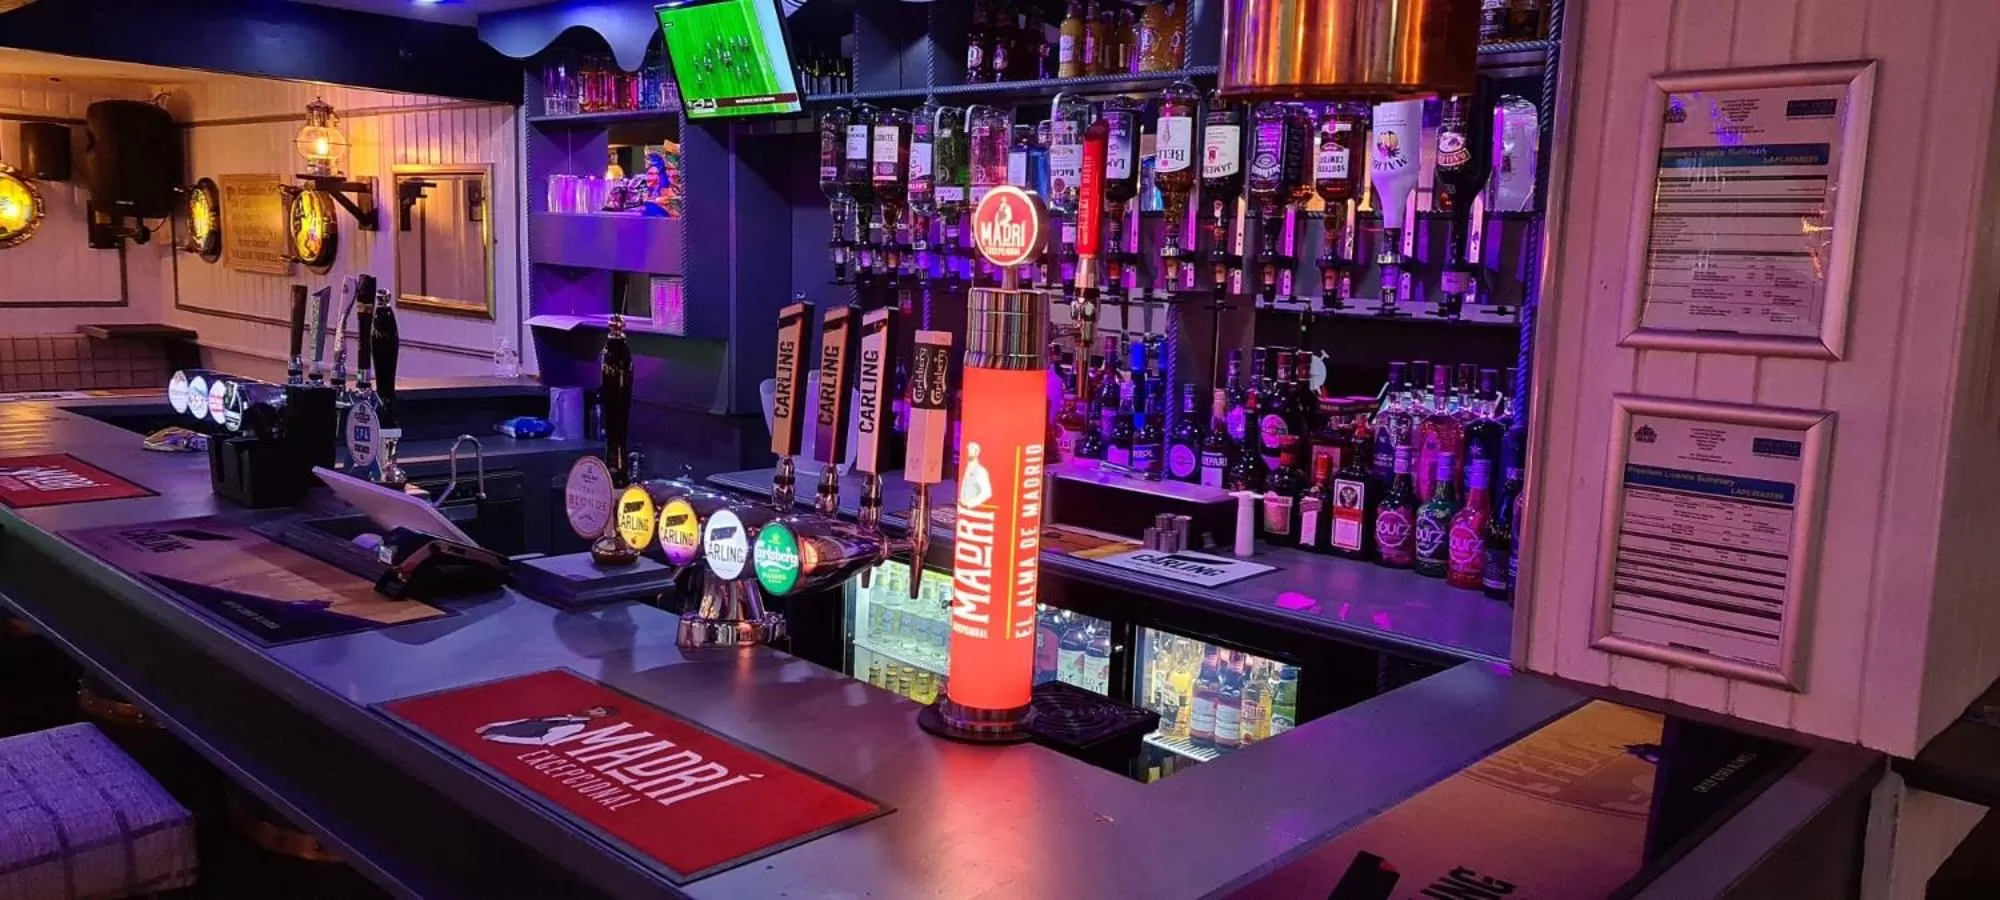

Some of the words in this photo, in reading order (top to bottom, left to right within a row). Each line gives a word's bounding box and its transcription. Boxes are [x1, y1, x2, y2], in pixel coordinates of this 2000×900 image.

[773, 340, 794, 419] CARLING
[819, 345, 841, 427] CARLING
[859, 350, 879, 434] CARLING
[912, 347, 929, 404] Carlsberg
[930, 349, 949, 405] Carlsberg
[1021, 443, 1043, 519] MADRID
[706, 542, 745, 564] ARLING
[1020, 525, 1038, 550] DE
[1131, 554, 1226, 577] CARLING
[1017, 556, 1036, 608] ALMA
[1015, 612, 1034, 639] EL
[516, 749, 641, 812] EXCEPCIONAL
[548, 721, 765, 806] MADRÍ
